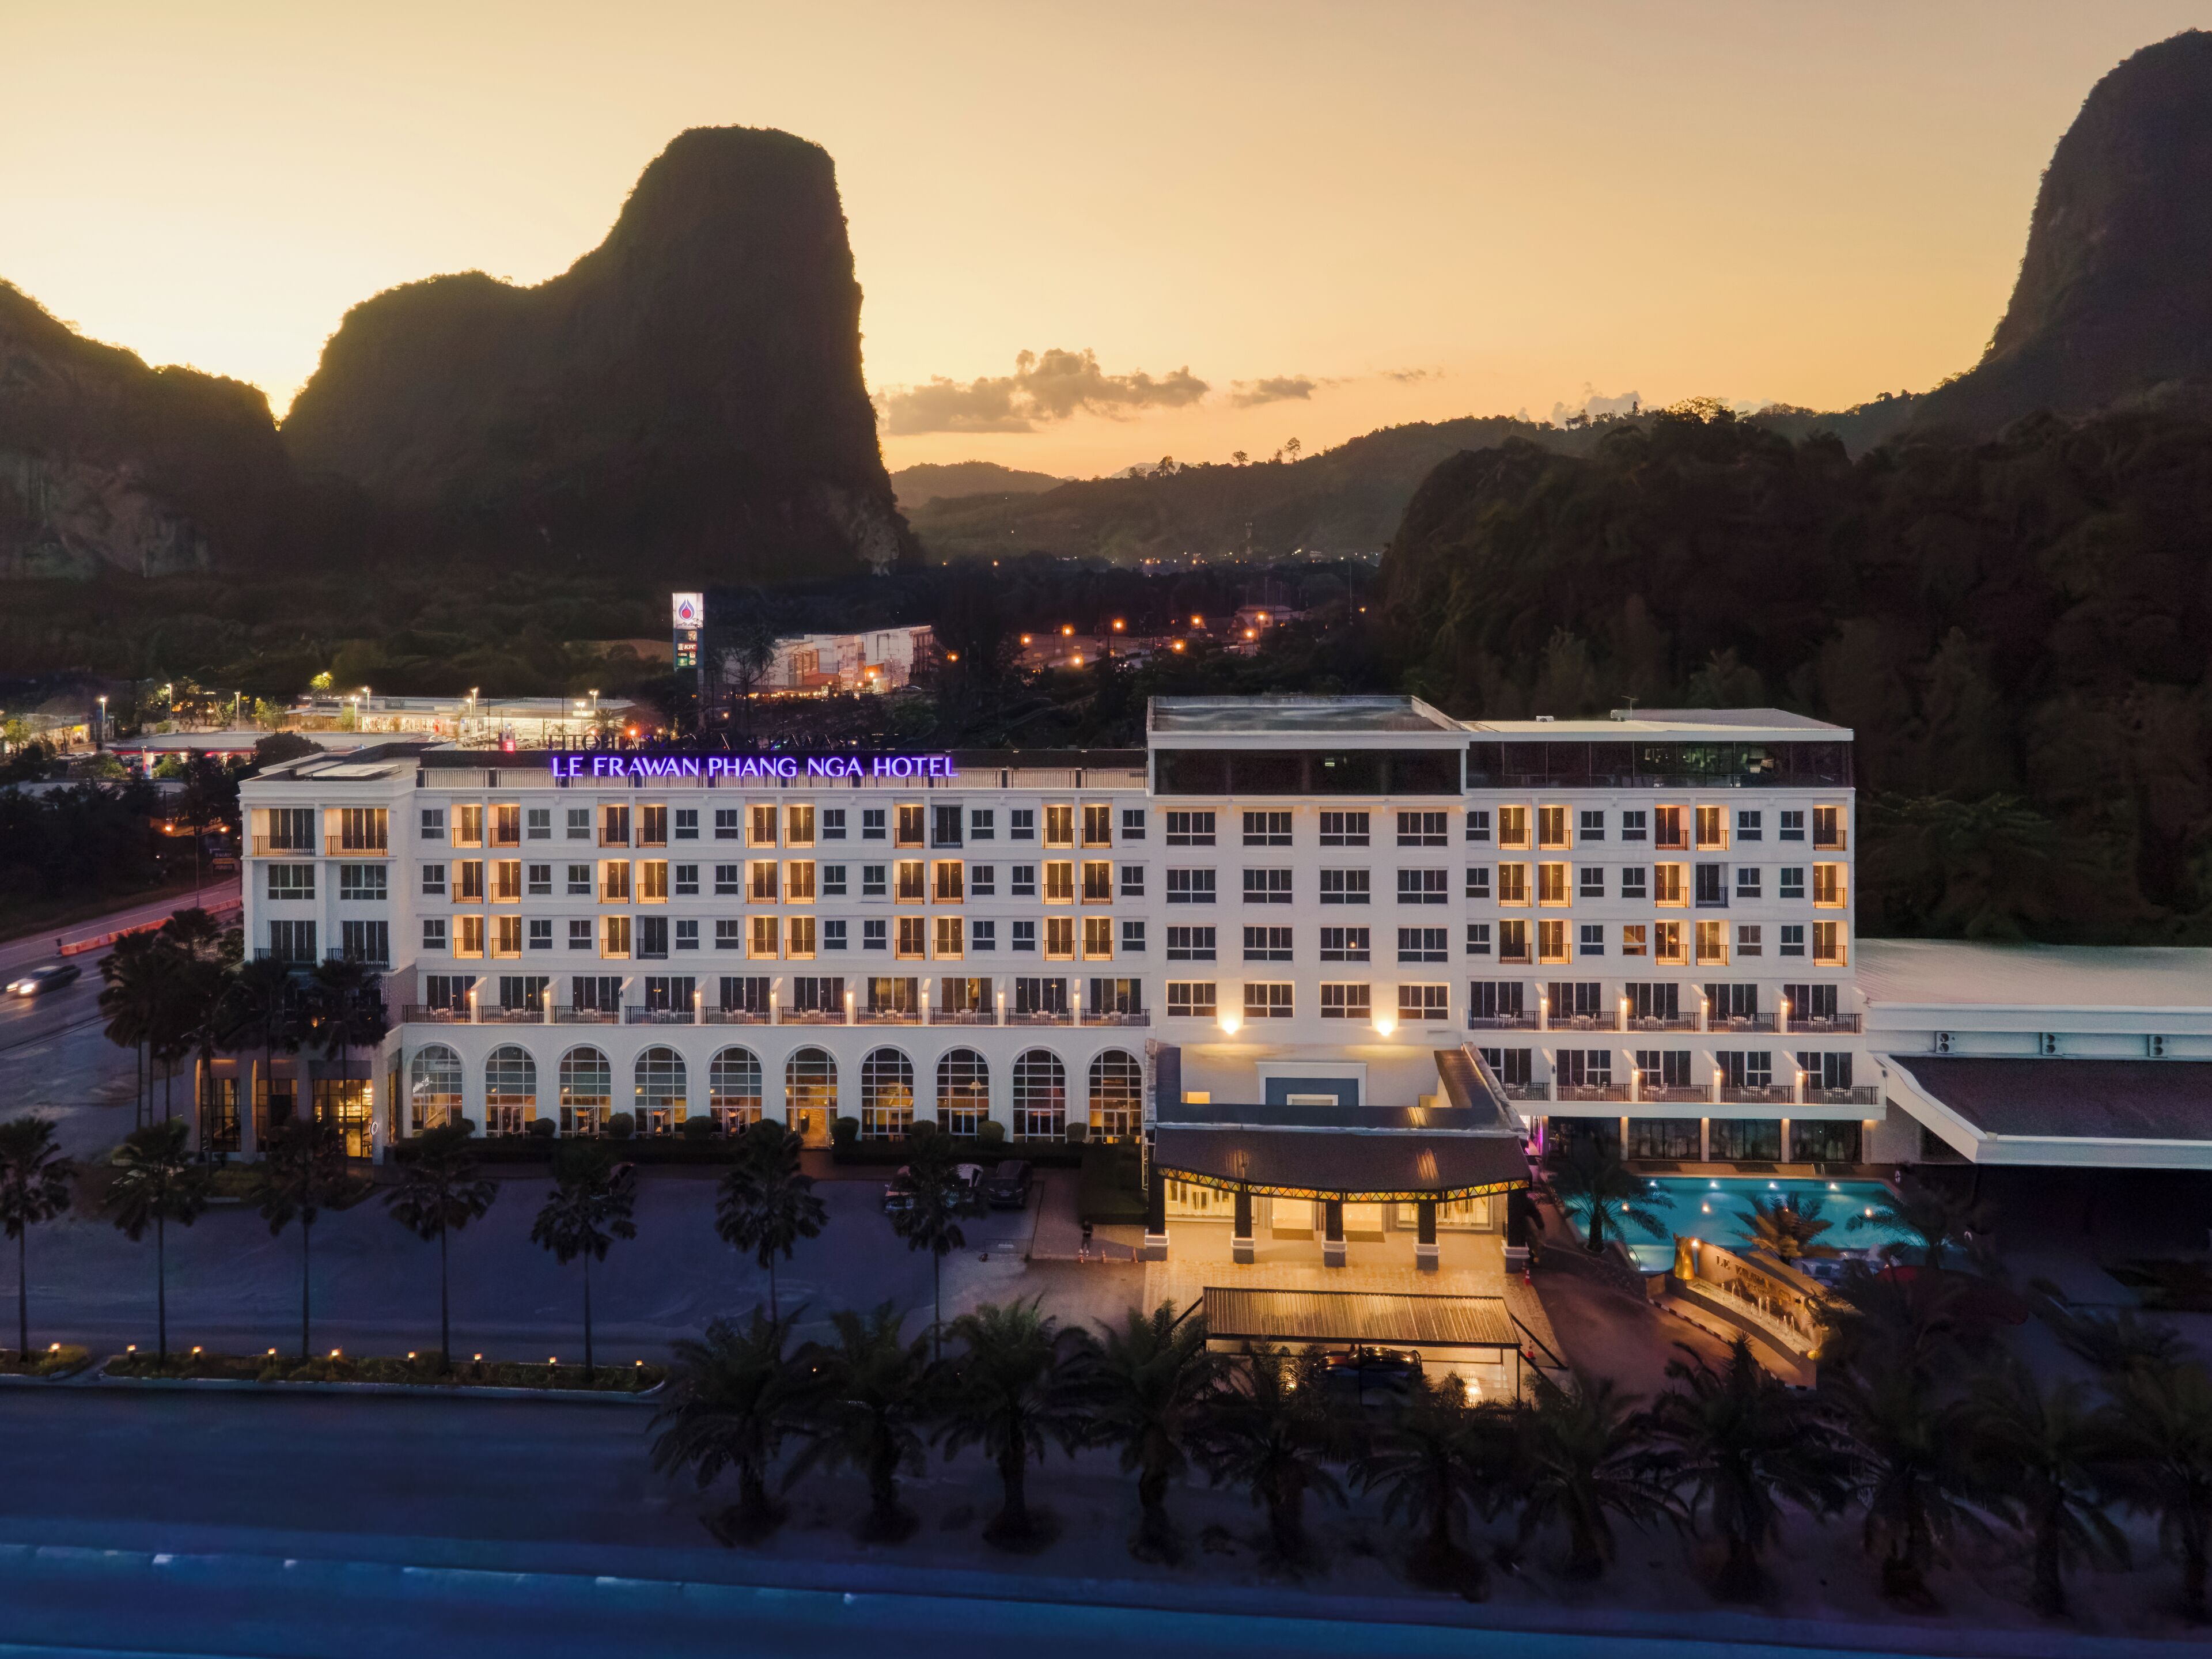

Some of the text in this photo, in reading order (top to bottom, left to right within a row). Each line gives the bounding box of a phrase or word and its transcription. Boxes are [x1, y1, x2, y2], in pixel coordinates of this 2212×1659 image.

[552, 756, 960, 778] LE FRAWAN PHANG NGA HOTEL
